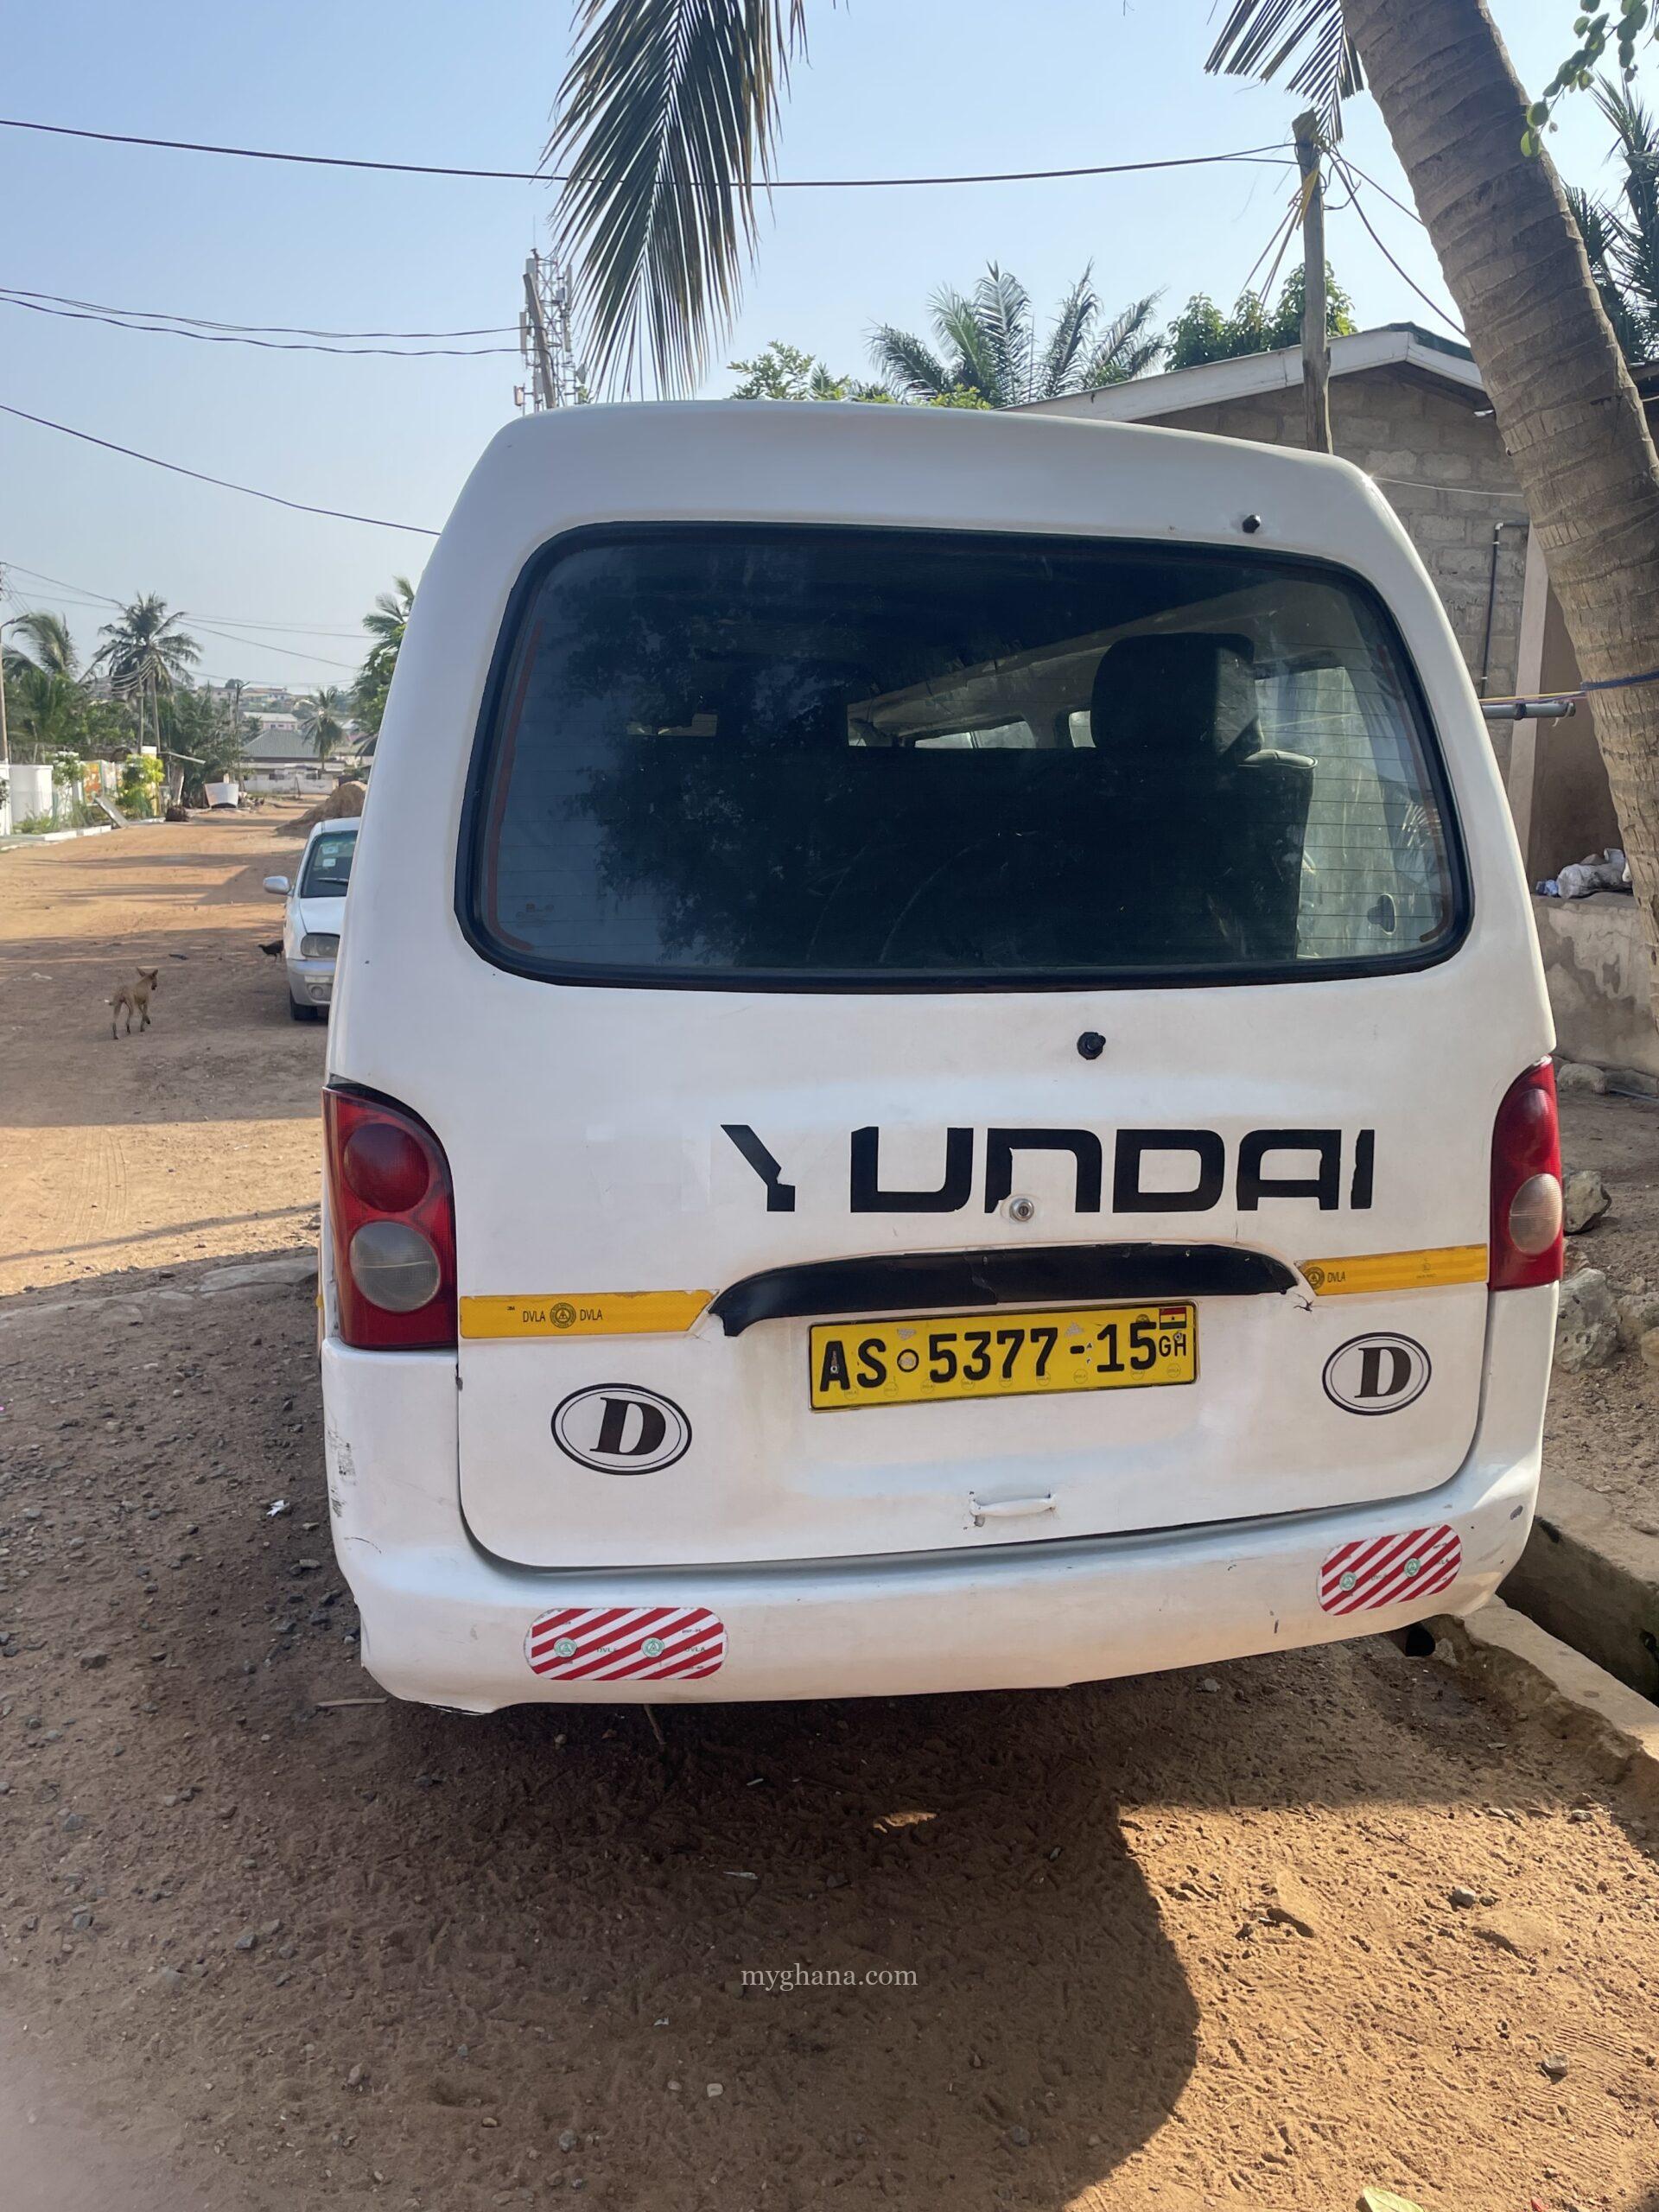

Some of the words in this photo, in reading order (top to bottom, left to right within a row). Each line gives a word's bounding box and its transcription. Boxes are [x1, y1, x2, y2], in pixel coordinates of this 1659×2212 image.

[1326, 1271, 1346, 1283] DVLA
[523, 1310, 546, 1323] DVLA
[580, 1308, 603, 1321] DVLA
[819, 1338, 887, 1392] AS
[1159, 1332, 1186, 1357] GH
[1354, 1346, 1412, 1398] D
[589, 1396, 666, 1456] D
